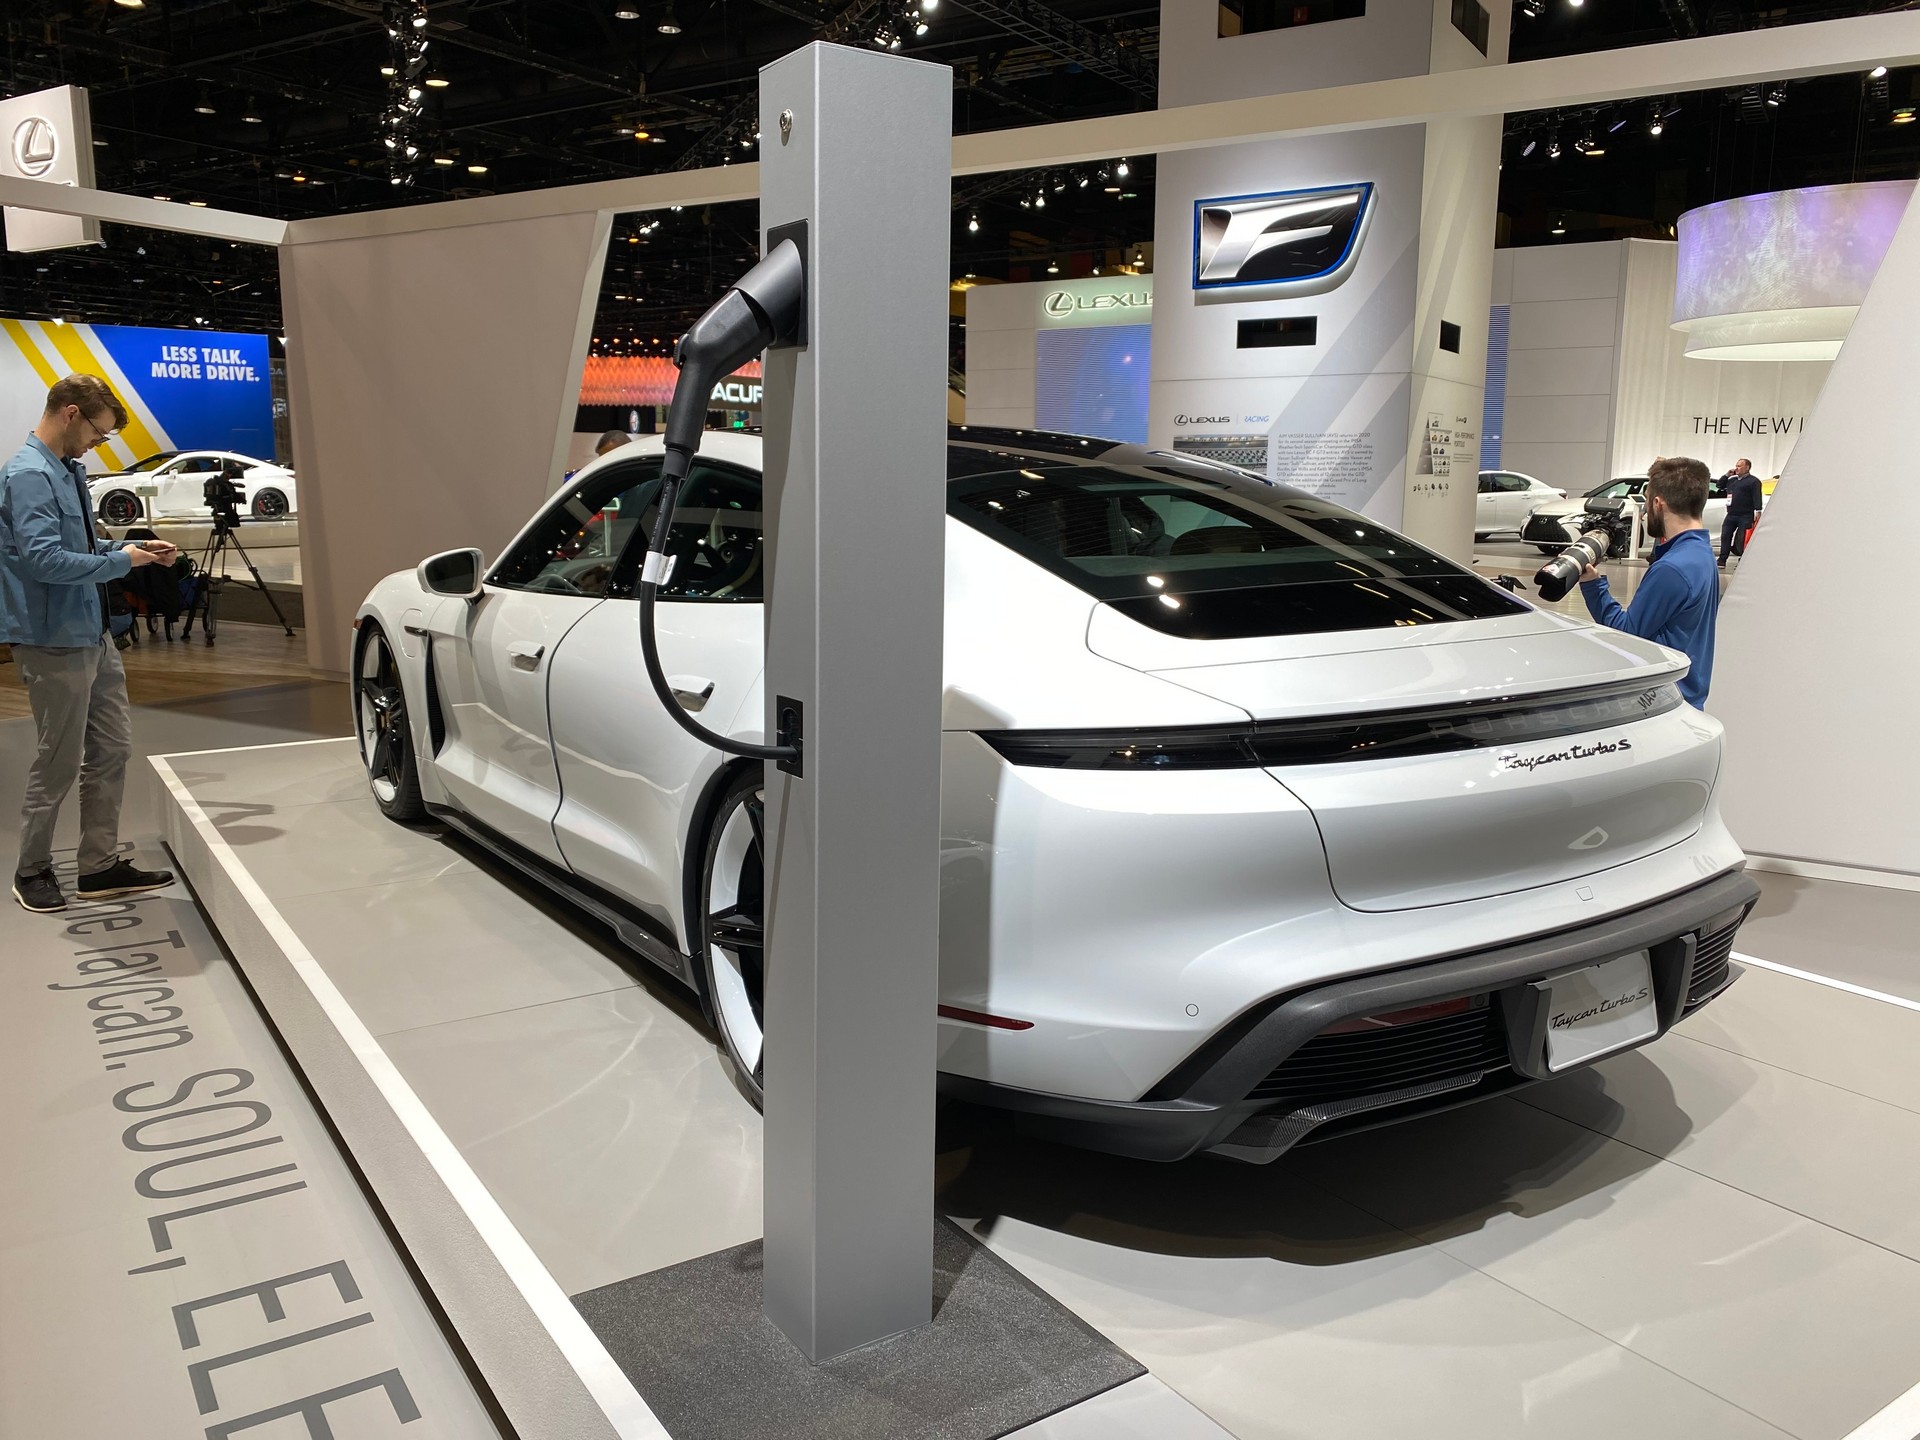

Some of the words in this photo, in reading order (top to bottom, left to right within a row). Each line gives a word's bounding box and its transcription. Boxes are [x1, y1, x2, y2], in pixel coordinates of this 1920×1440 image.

[1077, 292, 1153, 310] LEXU
[162, 345, 198, 362] LESS
[201, 347, 247, 366] TALK.
[151, 362, 202, 379] MORE
[206, 364, 260, 382] DRIVE.
[1189, 416, 1231, 424] LEXUS
[1693, 417, 1731, 434] THE
[1738, 417, 1794, 434] NEW
[1498, 753, 1572, 771] Taycan
[1570, 742, 1617, 759] turbo
[1616, 738, 1632, 751] S
[47, 929, 194, 1071] Taycan.
[1551, 1007, 1598, 1029] Taycan
[1599, 993, 1636, 1013] turbo
[1635, 987, 1648, 1000] S
[112, 1067, 308, 1276] SOUL,
